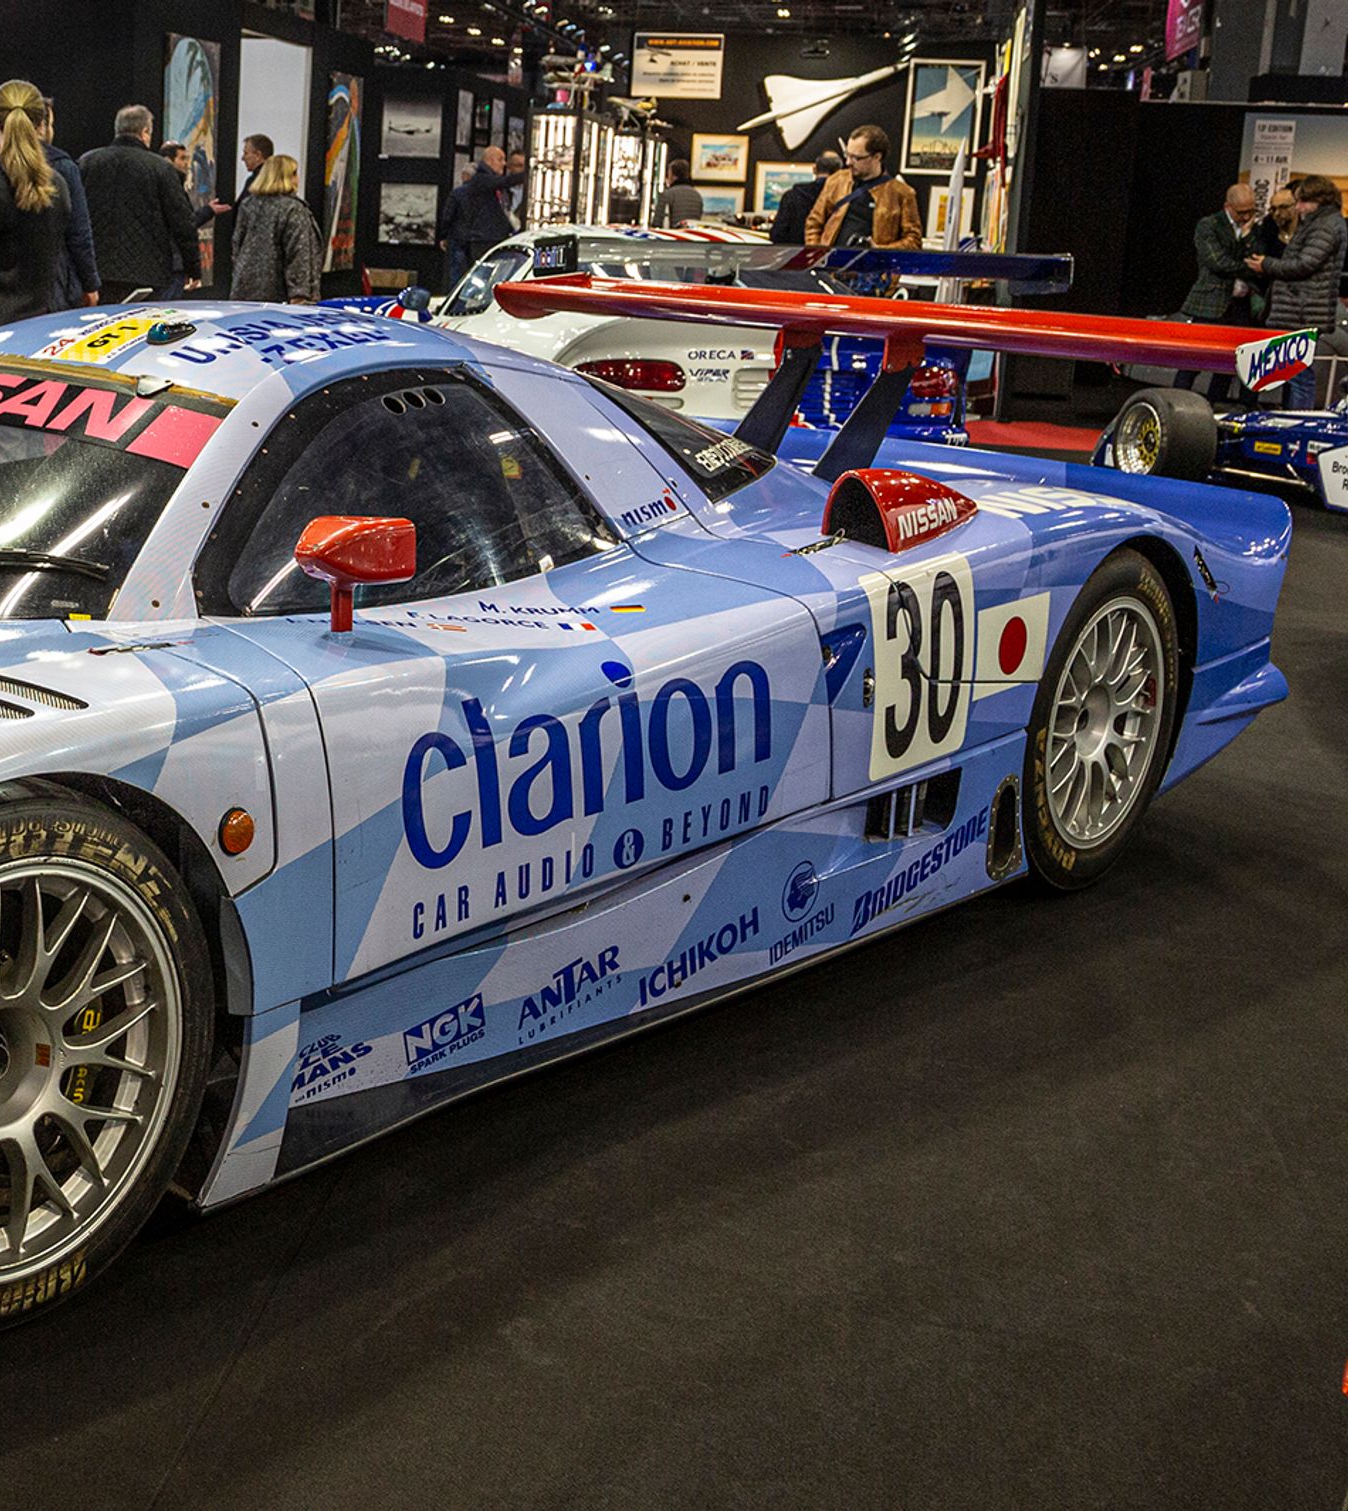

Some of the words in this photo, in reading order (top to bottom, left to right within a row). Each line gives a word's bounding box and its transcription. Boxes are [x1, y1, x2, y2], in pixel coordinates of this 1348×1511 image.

[86, 332, 121, 349] GT
[688, 349, 737, 361] ORECA
[1247, 331, 1310, 387] MEXICO
[897, 496, 958, 540] NISSAN
[428, 613, 550, 630] LAGORCE
[509, 605, 601, 616] KRUMM
[885, 571, 964, 760] 30
[412, 885, 470, 940] CAR
[494, 842, 595, 908] AUDIO
[661, 784, 770, 852] BEYOND
[849, 805, 989, 939] BRIDGESTONE
[639, 906, 761, 1007] ICHIKOH
[769, 902, 836, 967] IDEMITSU
[517, 945, 621, 1031] ANTAR
[518, 974, 622, 1046] LUBRIFIANTS
[298, 1033, 342, 1059] CLUB
[406, 997, 483, 1062] NGK
[410, 1049, 447, 1074] SPARK
[449, 1028, 486, 1054] PLUGS
[290, 1041, 373, 1094] MANS
[299, 1042, 344, 1072] LE
